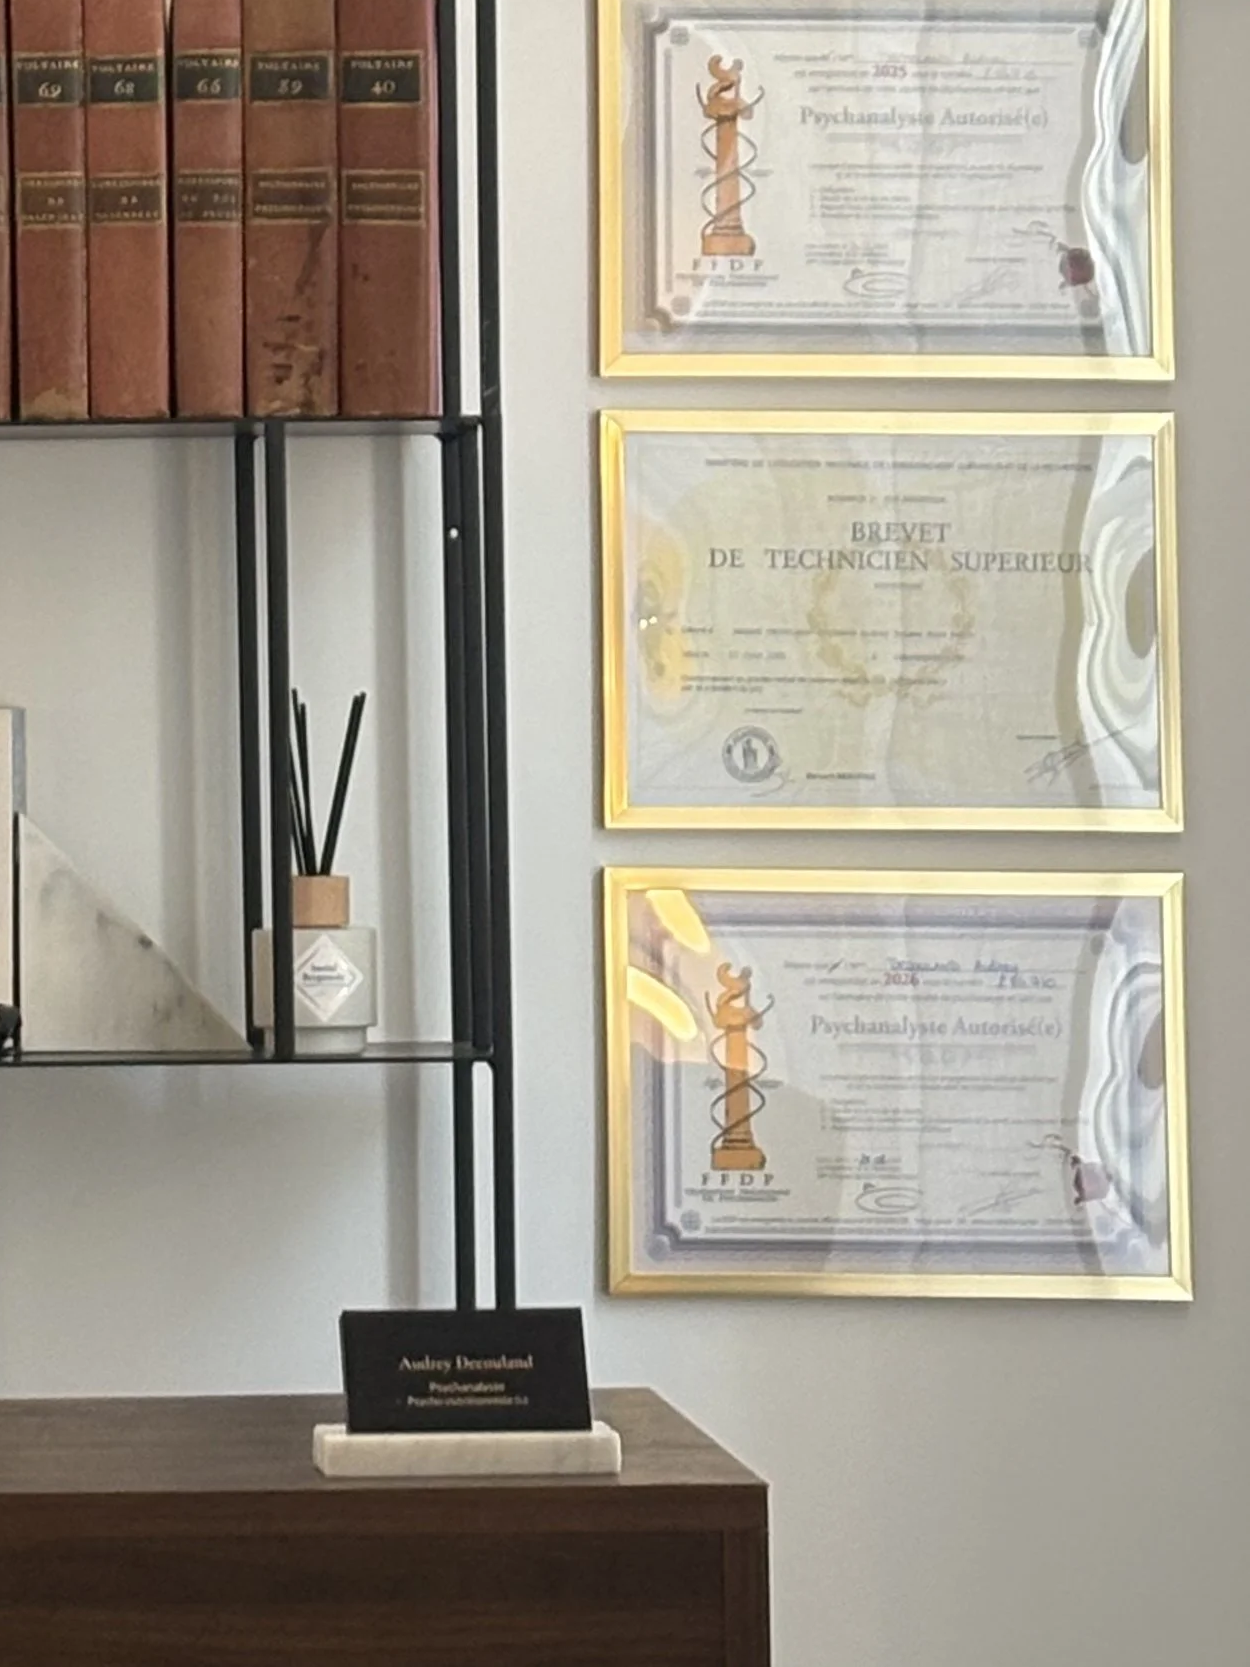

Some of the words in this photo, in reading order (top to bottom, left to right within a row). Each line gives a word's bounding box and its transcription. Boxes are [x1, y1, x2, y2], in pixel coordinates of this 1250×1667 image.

[15, 59, 80, 72] VOLTAIRE
[91, 62, 155, 74] VOLTAIRE
[177, 57, 241, 70] VOLTAIRE
[257, 60, 321, 72] VOLTAIRE
[350, 59, 414, 71] VOLTAIRE
[872, 64, 908, 79] 2025
[37, 81, 63, 99] 69
[113, 78, 136, 97] 68
[370, 79, 396, 96] 40
[798, 105, 935, 131] Psychanalyste
[940, 107, 1049, 129] Autorisé(e)
[850, 521, 952, 544] BREVET
[708, 547, 745, 570] DE
[765, 548, 929, 572] TECHNICIEN
[951, 550, 1093, 574] SUPERIEUR
[810, 1014, 947, 1040] Psychanalyste
[953, 1015, 1063, 1038] Autorisé(e)
[399, 1354, 452, 1374] Audrey
